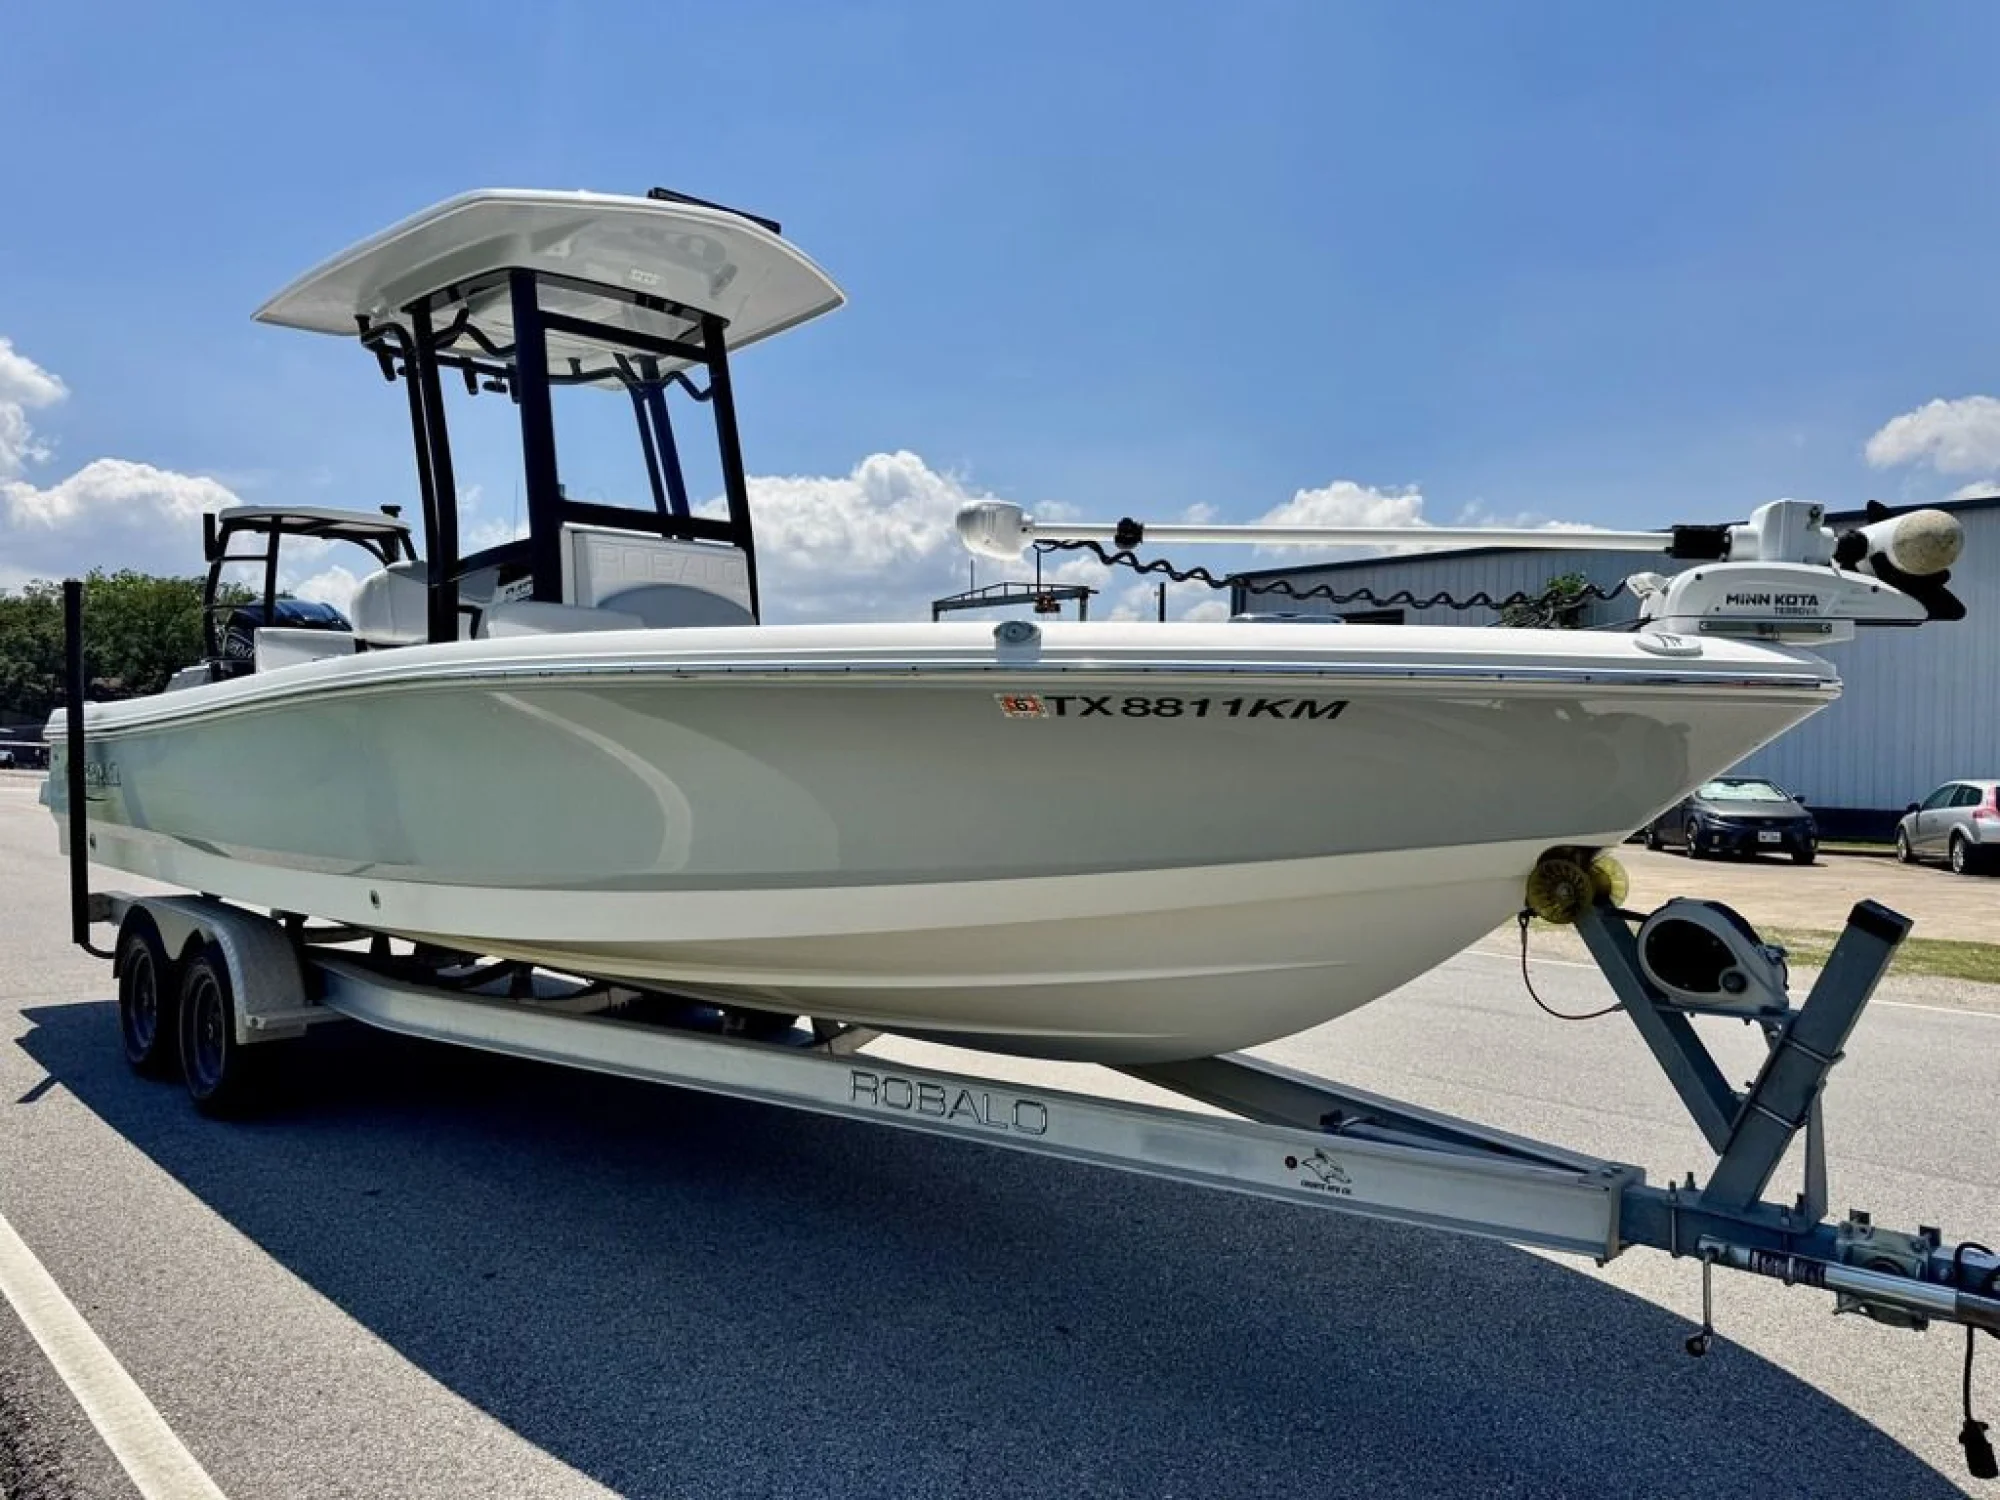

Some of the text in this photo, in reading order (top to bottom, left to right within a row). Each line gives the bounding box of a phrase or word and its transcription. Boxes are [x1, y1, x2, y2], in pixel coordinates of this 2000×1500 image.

[1726, 593, 1819, 606] MINN KOTA
[851, 1070, 1048, 1135] ROBALO
